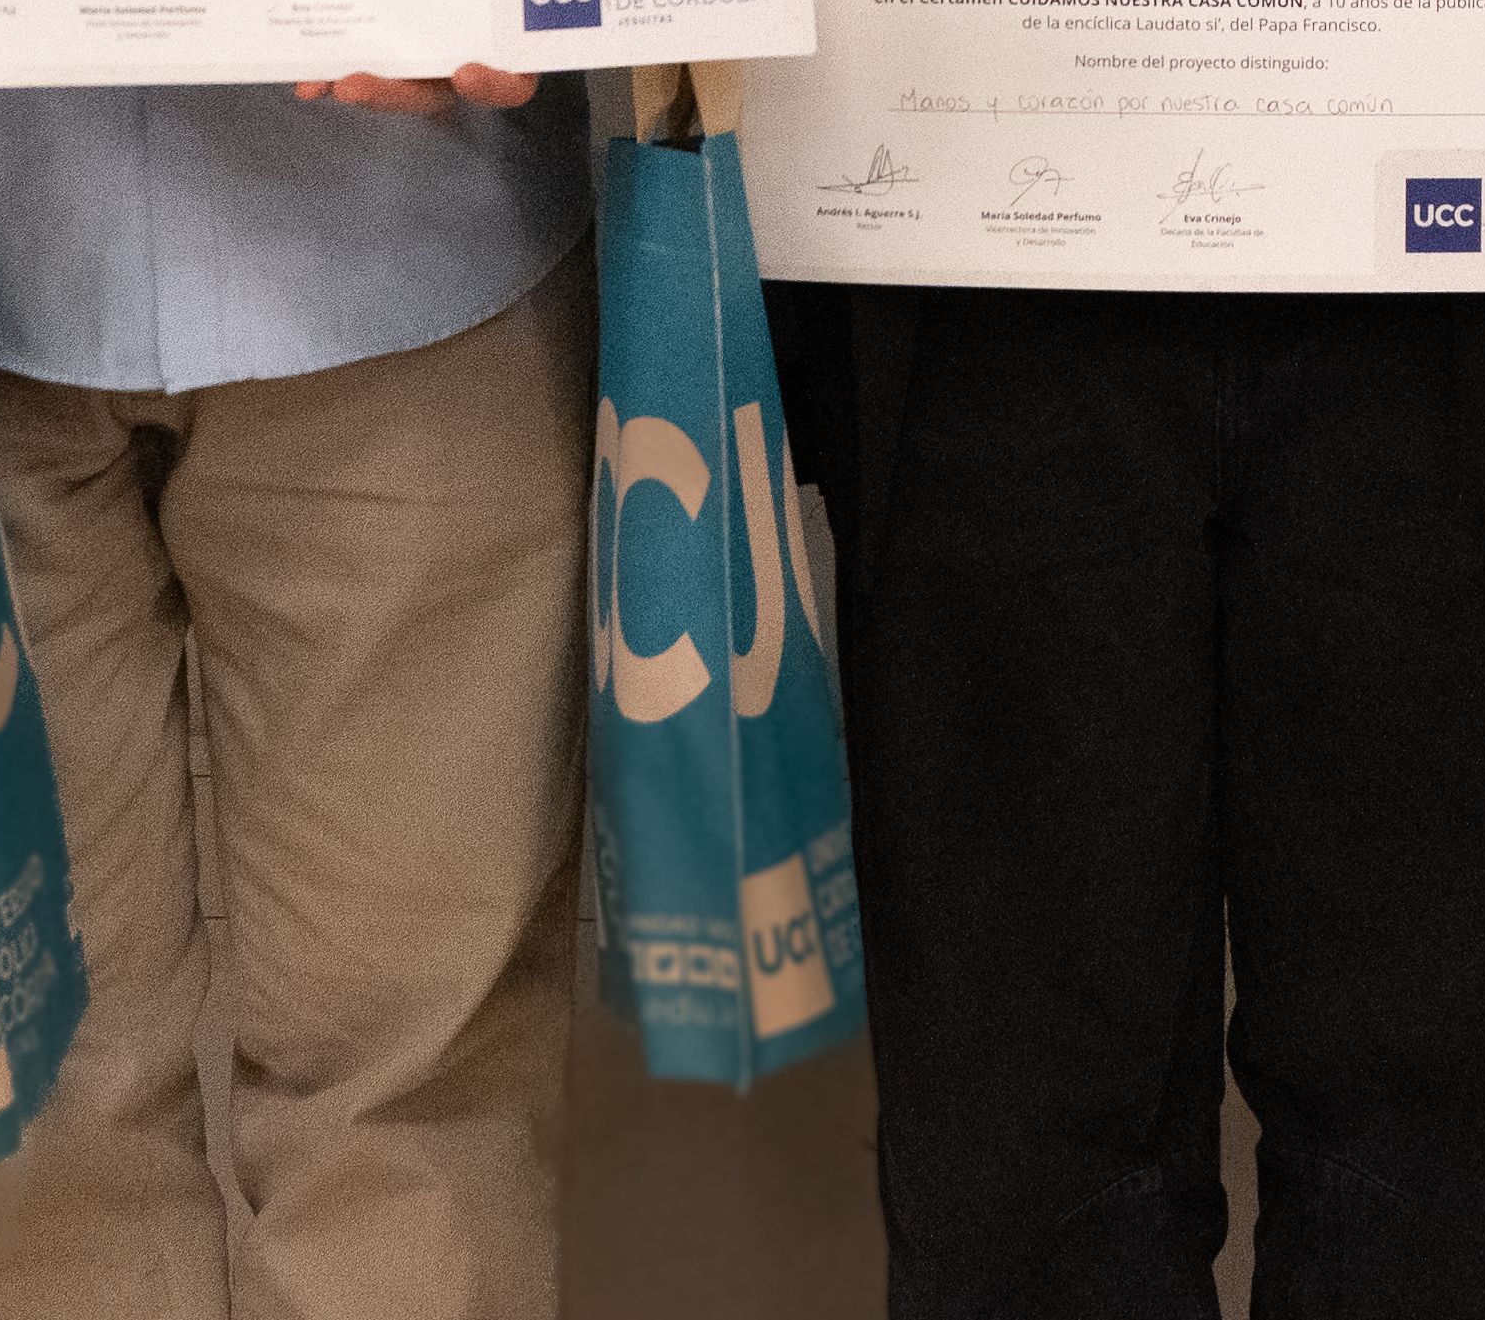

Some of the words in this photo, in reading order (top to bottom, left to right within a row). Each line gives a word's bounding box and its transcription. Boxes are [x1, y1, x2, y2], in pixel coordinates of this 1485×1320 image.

[1021, 15, 1042, 30] de
[1046, 15, 1061, 30] la
[1064, 16, 1132, 31] encíclica
[1136, 17, 1202, 32] Laudato
[1229, 17, 1254, 32] del
[1258, 17, 1298, 36] Papa
[1302, 17, 1381, 33] Francisco.
[1074, 54, 1138, 69] Nombre
[1140, 55, 1165, 69] del
[1168, 57, 1237, 73] proyecto
[1239, 55, 1329, 73] distinguido:
[986, 94, 1000, 122] y
[1414, 203, 1475, 229] UCC
